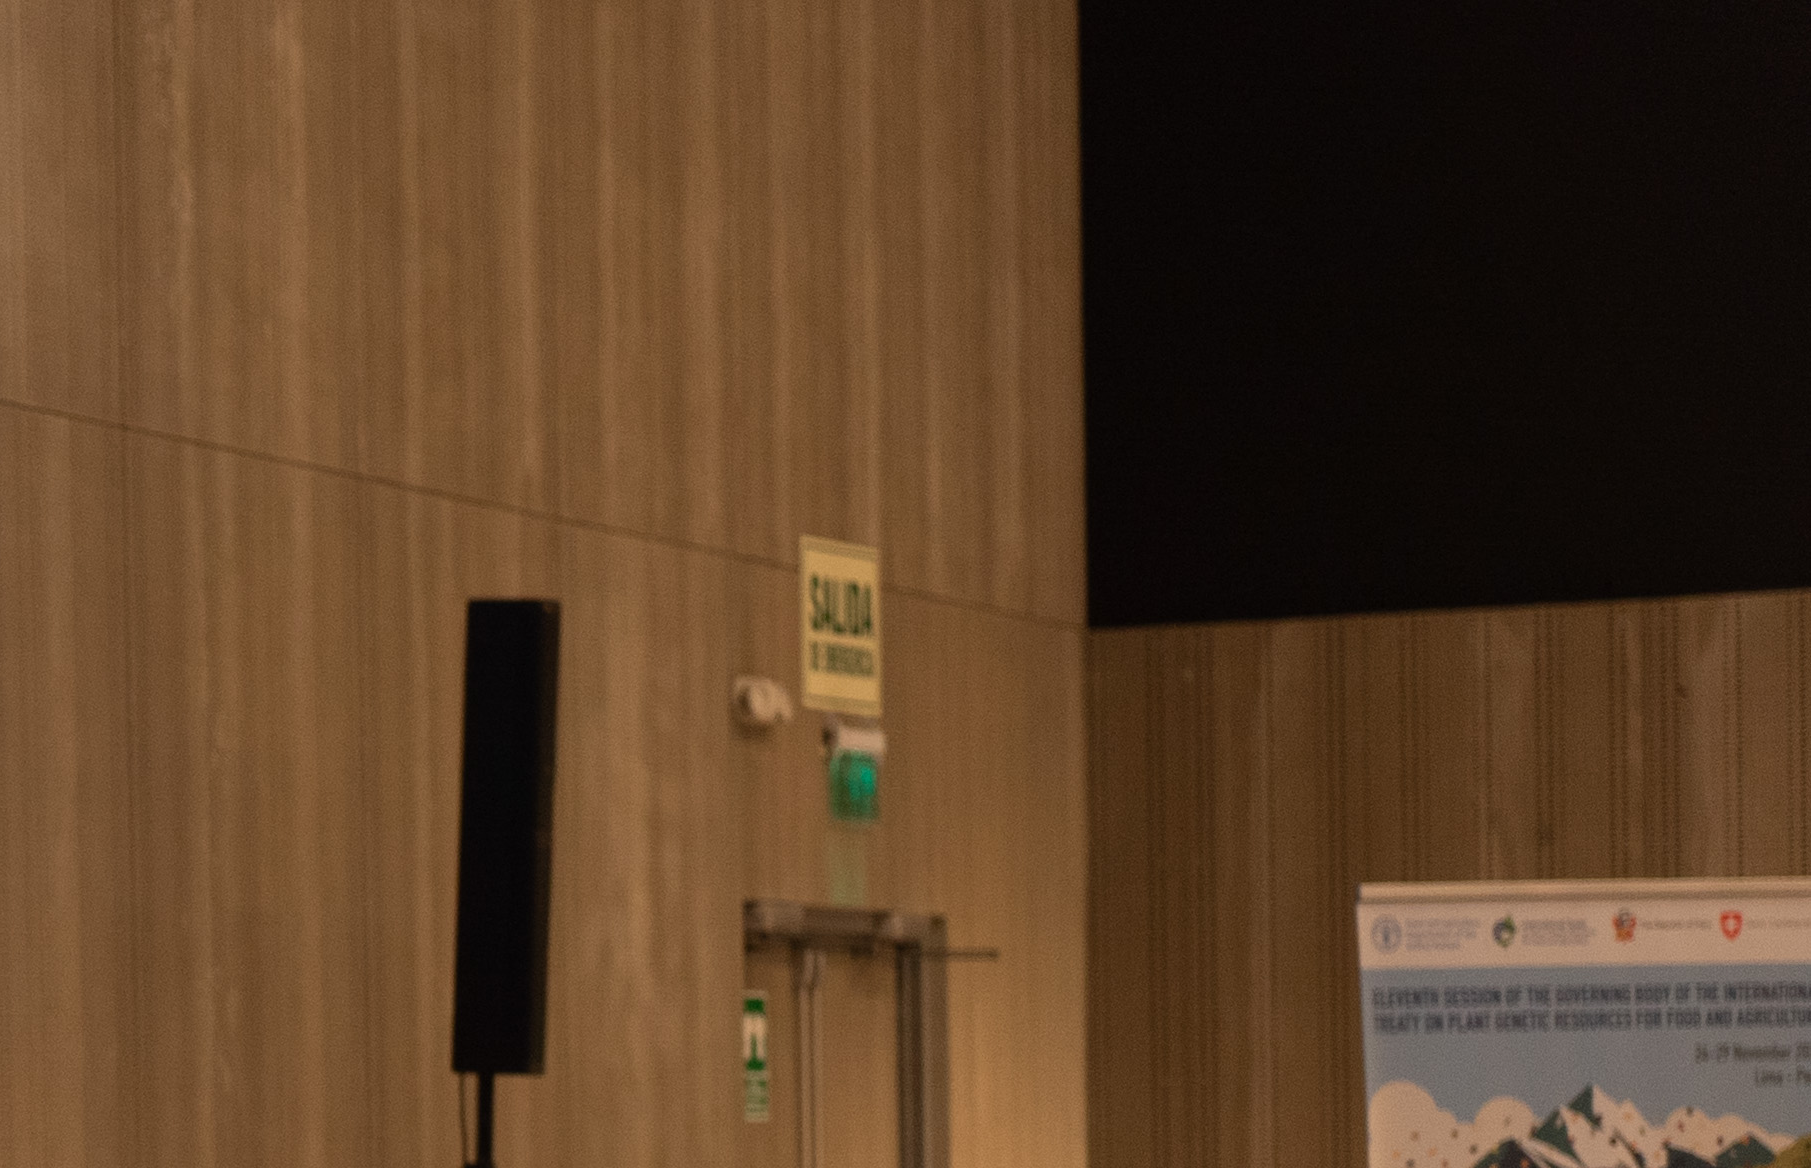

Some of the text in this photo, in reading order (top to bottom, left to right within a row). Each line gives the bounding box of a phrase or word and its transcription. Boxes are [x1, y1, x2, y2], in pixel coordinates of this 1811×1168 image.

[811, 573, 872, 636] SALIDA
[1374, 986, 1440, 1009] ELEVENTH
[1444, 984, 1501, 1008] SESSION
[1506, 983, 1523, 1008] OF
[1528, 983, 1550, 1006] THE
[1555, 983, 1631, 1005] GOVERNING
[1636, 982, 1670, 1004] BODY
[1675, 981, 1691, 1003] OF
[1696, 981, 1719, 1003] THE
[1375, 1011, 1420, 1033] TREATY
[1425, 1010, 1444, 1033] ON
[1448, 1010, 1490, 1032] PLANT
[1495, 1009, 1550, 1032] GENETIC
[1555, 1008, 1631, 1031] RESOURCES
[1636, 1008, 1662, 1029] FOR
[1667, 1007, 1701, 1029] FOOD
[1706, 1007, 1732, 1029] AND
